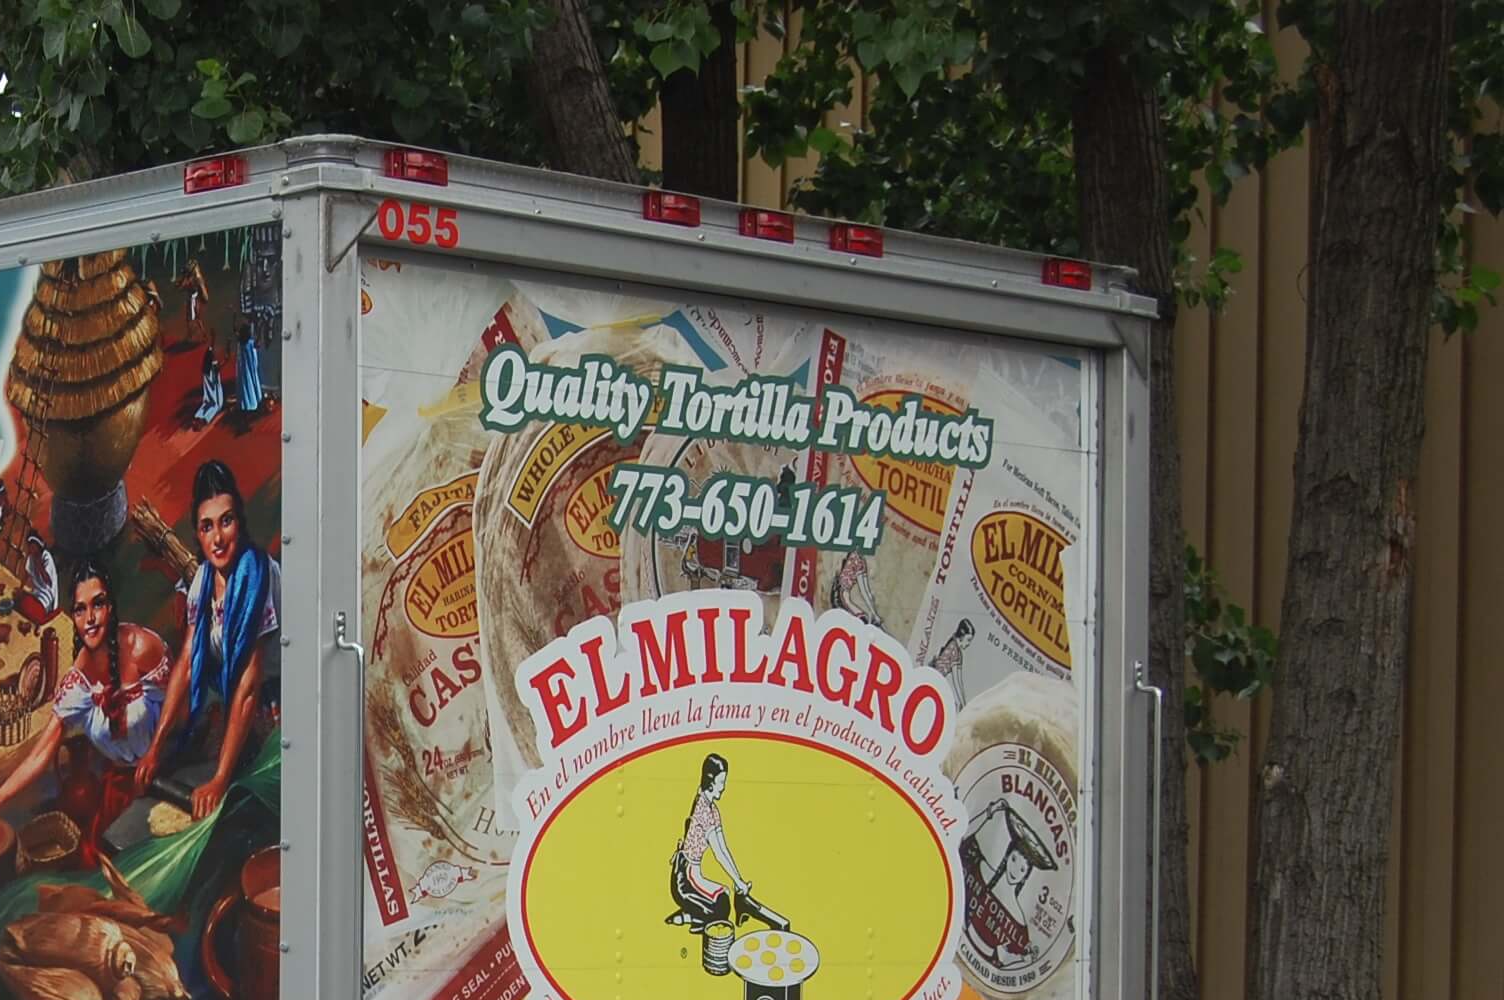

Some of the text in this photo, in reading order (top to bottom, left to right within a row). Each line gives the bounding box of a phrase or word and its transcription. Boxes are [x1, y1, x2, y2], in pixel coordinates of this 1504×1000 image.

[377, 197, 460, 249] 055
[484, 349, 650, 439] Quality
[662, 370, 812, 444] Tortilla
[817, 389, 991, 463] Products
[516, 424, 577, 506] WHOLE
[613, 468, 882, 549] 773-650-1614
[402, 649, 438, 688] Calidad
[422, 745, 444, 777] 24
[526, 695, 958, 836] En el nombre lleva la fama y en el producto la calidad.
[1001, 773, 1069, 859] BLANCAS
[1037, 886, 1050, 905] 3
[386, 942, 413, 970] WT.
[960, 943, 991, 979] CALIDAD
[990, 967, 1018, 988] DESDE
[461, 967, 491, 1000] SEAL
